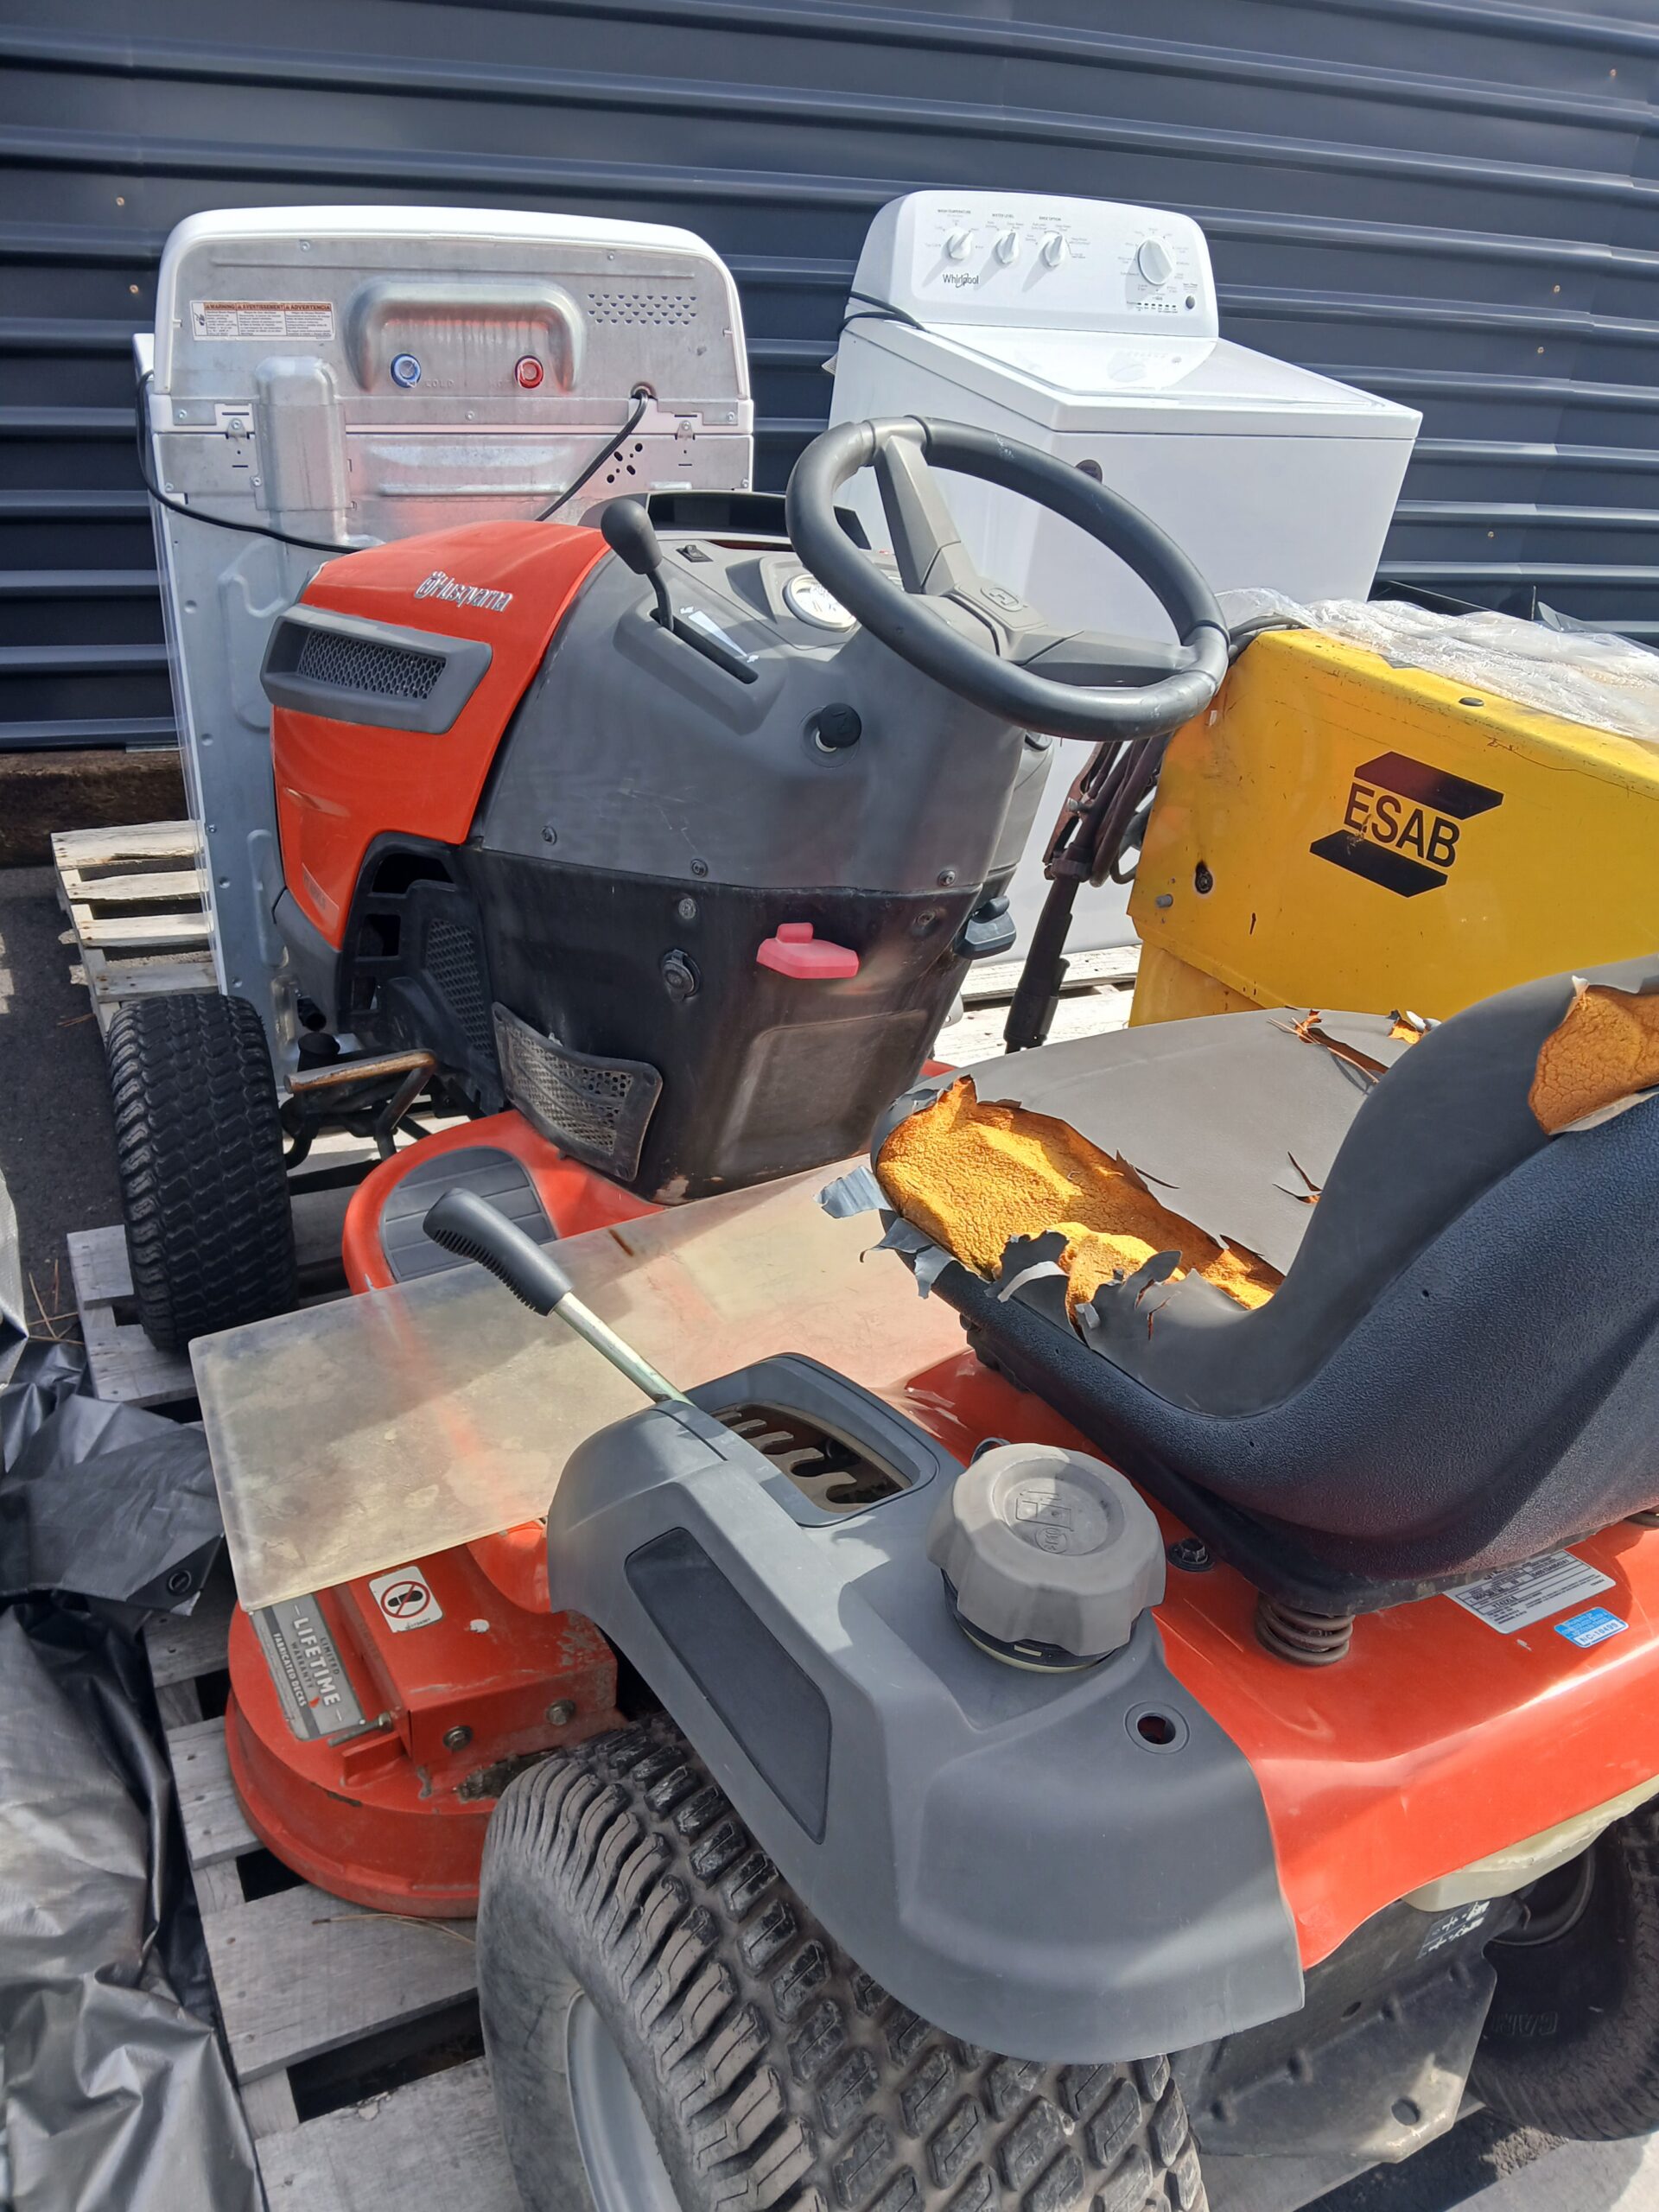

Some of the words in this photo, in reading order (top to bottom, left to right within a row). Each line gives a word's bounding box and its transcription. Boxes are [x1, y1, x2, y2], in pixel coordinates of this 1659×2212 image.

[943, 274, 979, 287] Whirlpool
[429, 575, 513, 612] Husqvarna
[1343, 781, 1461, 868] ESAB
[272, 1632, 296, 1681] FABRICATED
[290, 1680, 307, 1707] DECKS
[290, 1642, 315, 1689] WARRANTY
[293, 1617, 341, 1707] LIFETIME
[320, 1637, 340, 1675] LIMITED
